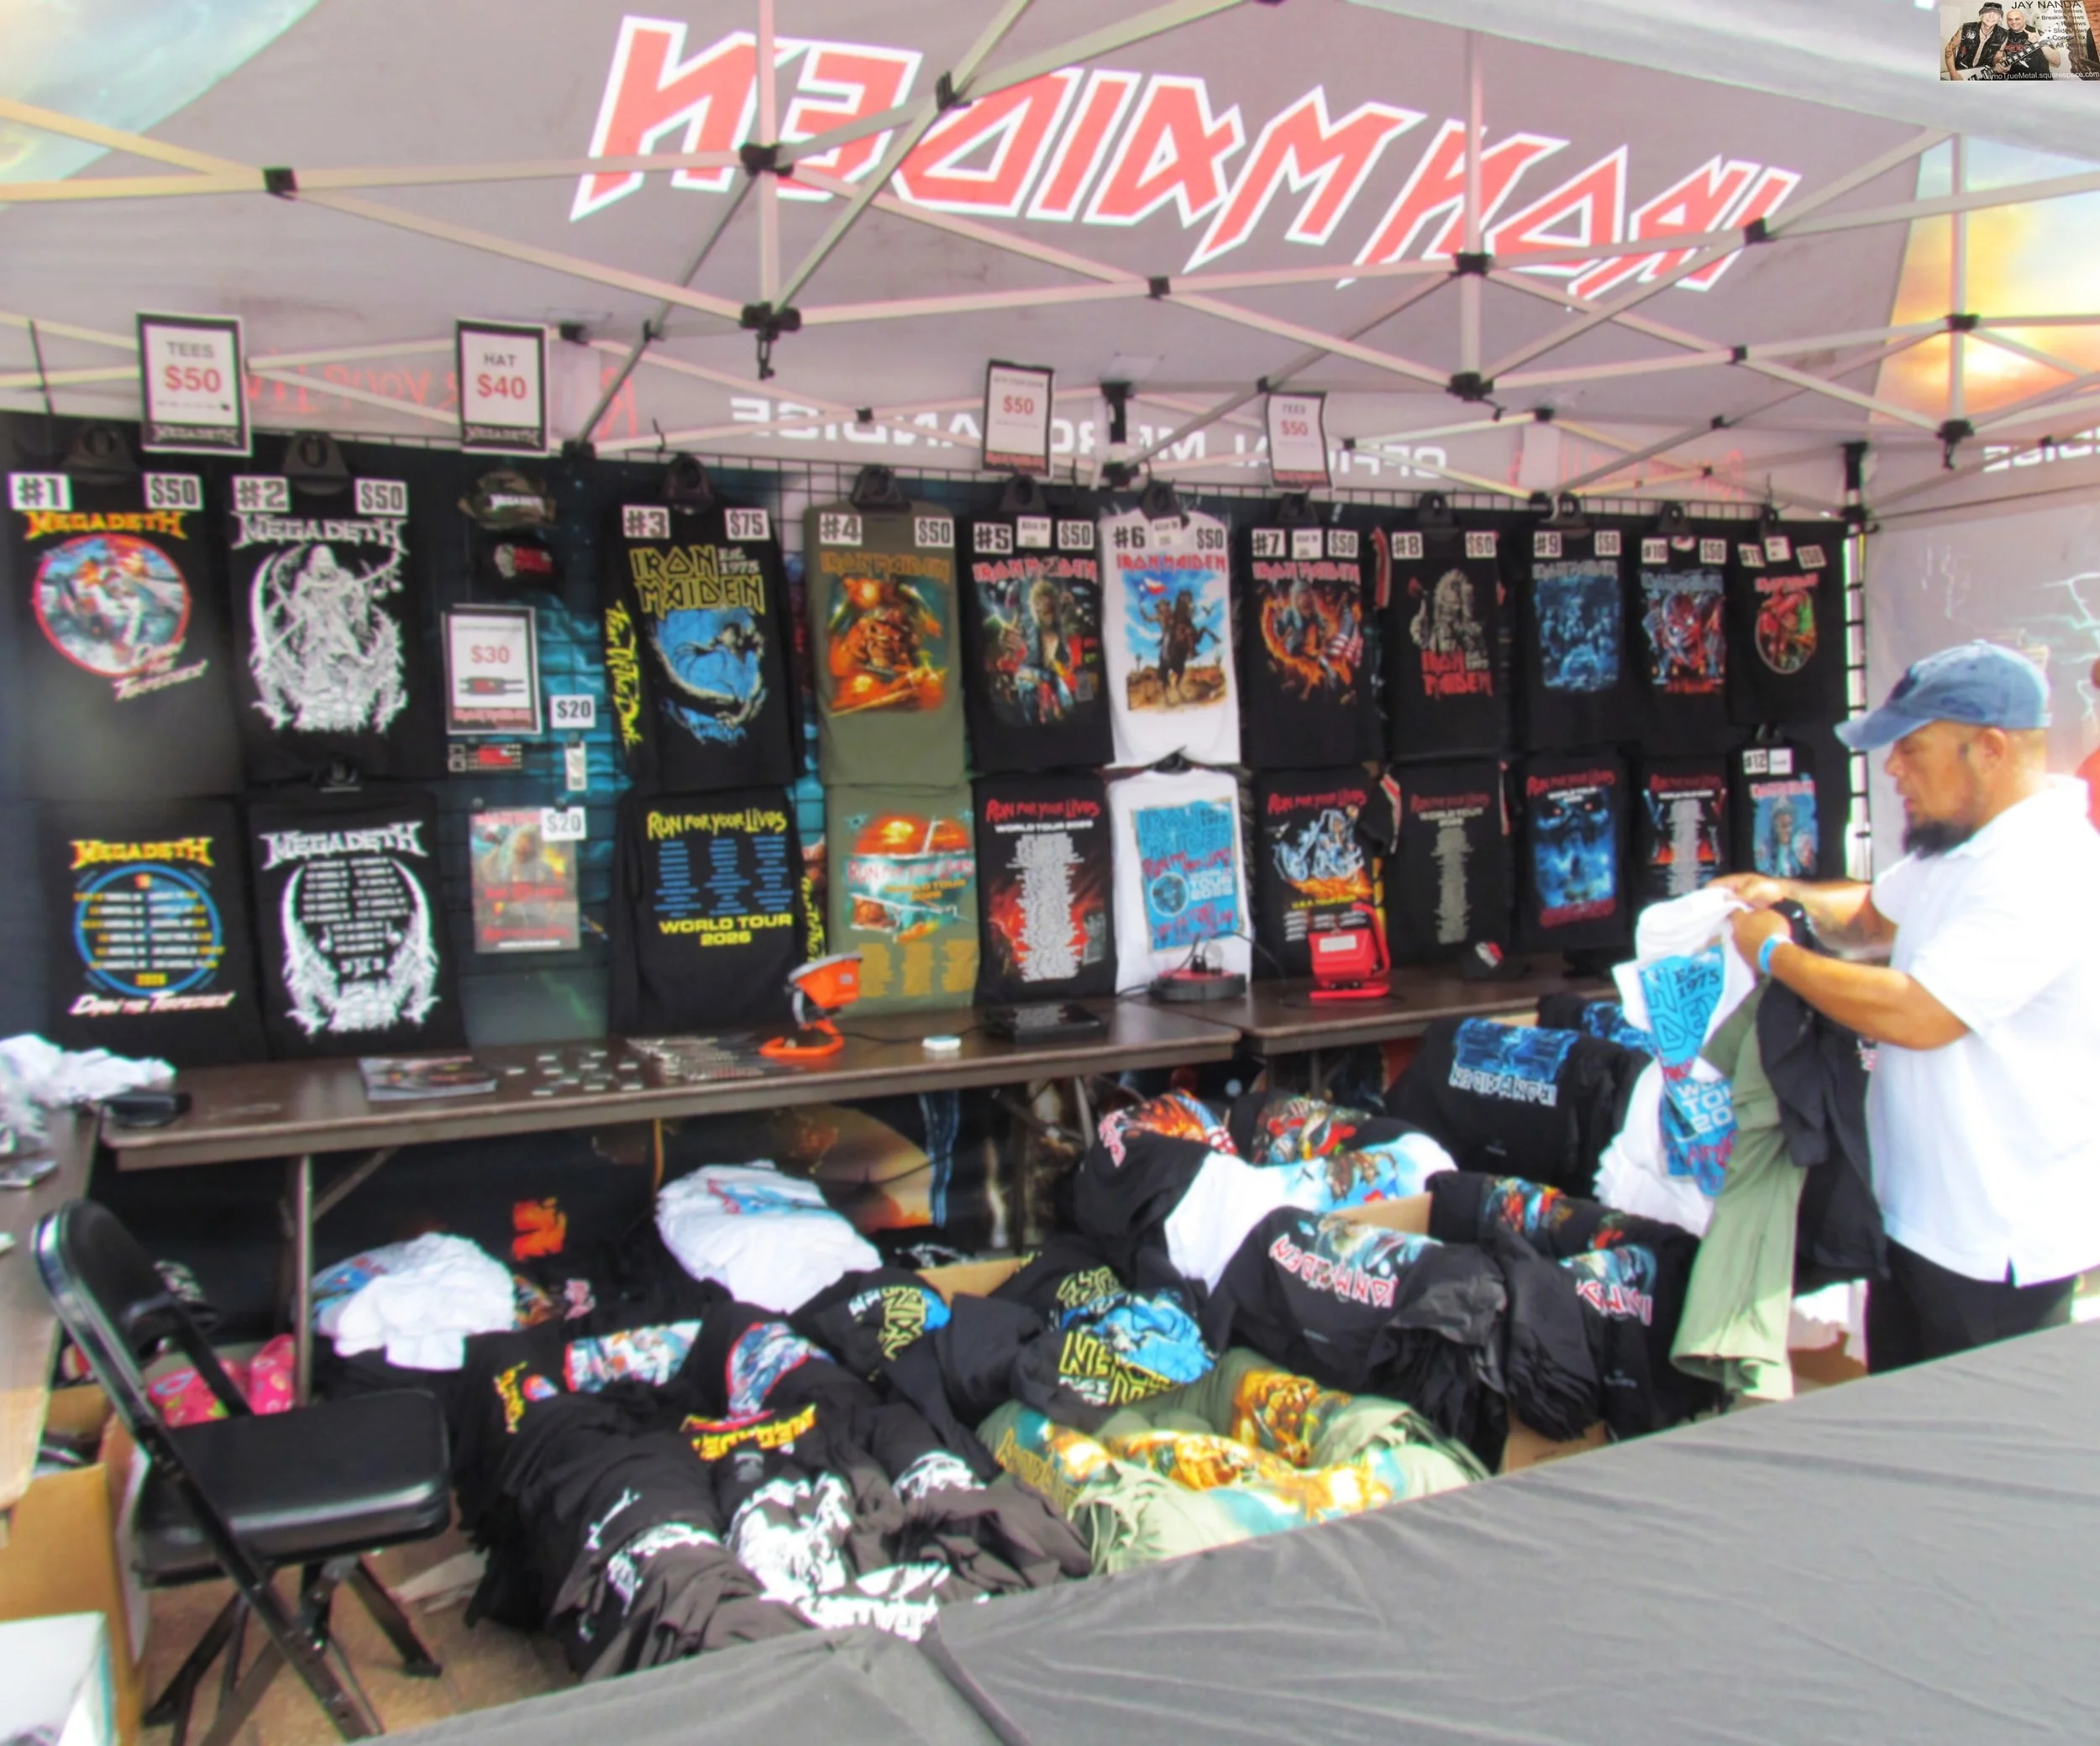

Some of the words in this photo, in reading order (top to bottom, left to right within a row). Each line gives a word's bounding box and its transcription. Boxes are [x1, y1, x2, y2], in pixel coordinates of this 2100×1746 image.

[165, 341, 214, 359] TEES
[484, 353, 517, 368] HAT
[164, 364, 222, 393] $50
[477, 374, 527, 401] $40
[1003, 396, 1034, 416] $50
[1281, 419, 1309, 436] $50
[18, 476, 63, 508] #1
[150, 476, 197, 506] $50
[239, 480, 286, 509] #2
[360, 482, 404, 511] $50
[23, 511, 188, 541] MEGADETH
[230, 511, 409, 553] MEGADETH
[626, 511, 666, 538] #3
[729, 511, 764, 536] $75
[822, 515, 860, 542] #4
[917, 520, 951, 544] $50
[1060, 523, 1091, 547] $50
[974, 525, 1011, 550] #5
[1114, 526, 1146, 550] #6
[1195, 527, 1224, 550] $50
[1252, 530, 1281, 555] #7
[1329, 531, 1357, 555] $50
[1394, 533, 1420, 556] #8
[1467, 532, 1494, 555] $60
[1535, 533, 1560, 557] #9
[629, 544, 719, 581] IRON
[1116, 554, 1159, 570] IRON
[1159, 553, 1226, 573] MAIDEN
[1643, 541, 1667, 563] #10
[973, 560, 1025, 583] IRON
[634, 574, 765, 620] MAIDEN
[470, 645, 511, 664] $30
[1421, 649, 1466, 674] IRON
[1420, 672, 1494, 700] MAIDEN
[556, 700, 592, 720] $20
[985, 799, 1016, 823] RUN
[1065, 799, 1101, 820] LIVES
[547, 814, 582, 833] $20
[647, 810, 683, 841] RUN
[684, 814, 710, 831] FOR
[710, 811, 745, 836] YOUR
[745, 807, 788, 834] LIVES
[69, 836, 215, 870] MEGADETH
[258, 820, 429, 870] MEGADETH
[659, 918, 734, 935] WORLD
[737, 913, 793, 930] TOUR
